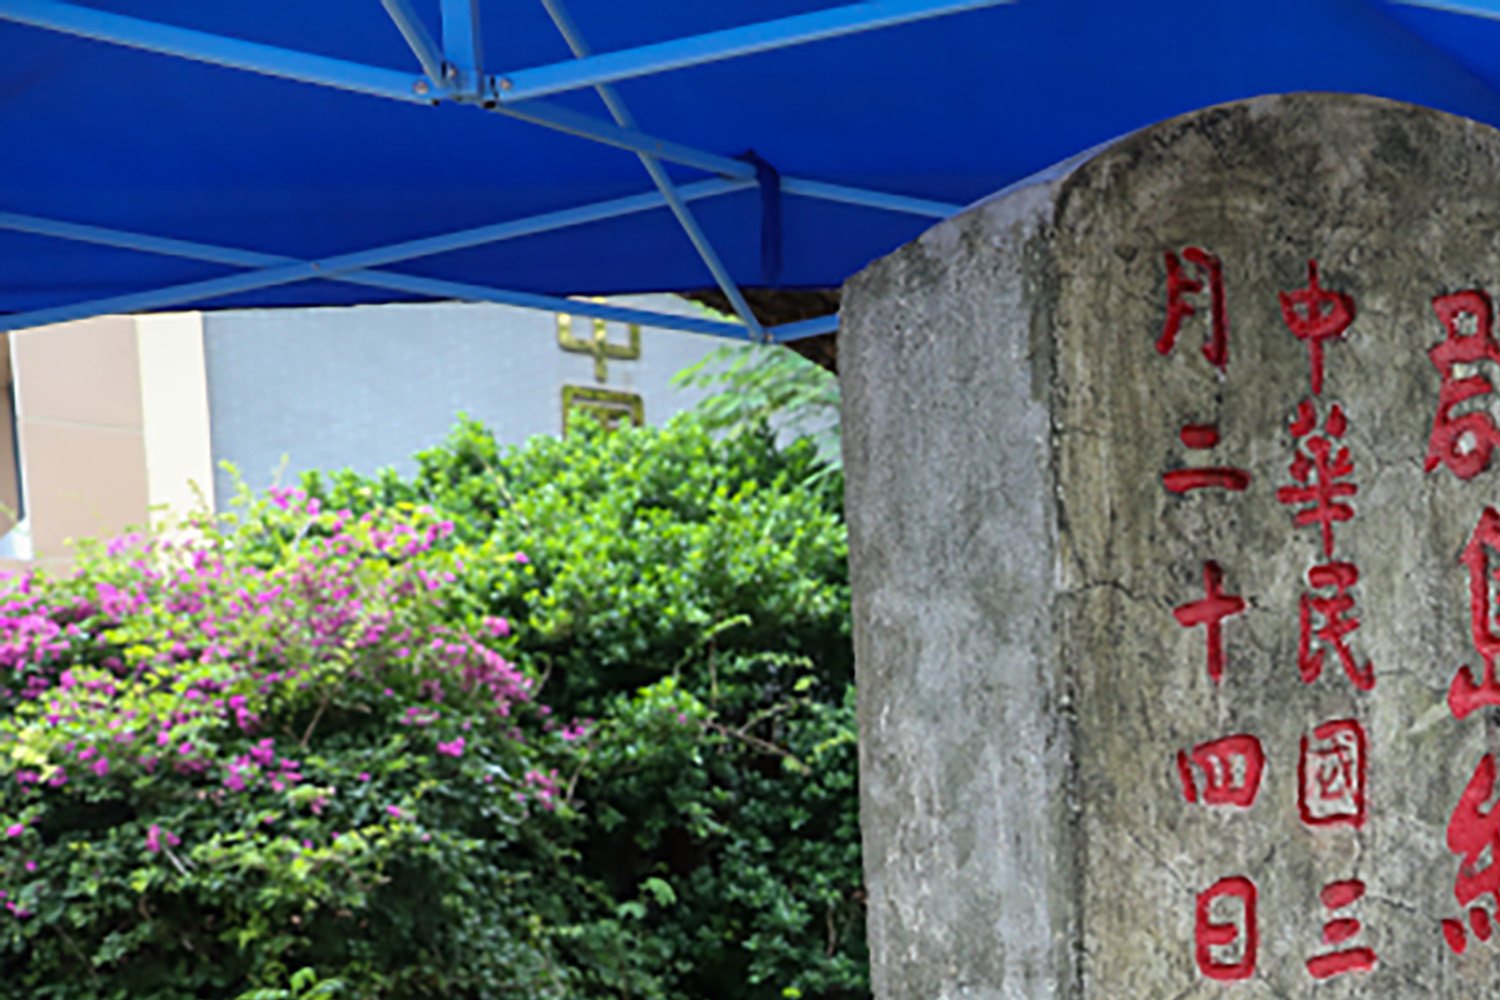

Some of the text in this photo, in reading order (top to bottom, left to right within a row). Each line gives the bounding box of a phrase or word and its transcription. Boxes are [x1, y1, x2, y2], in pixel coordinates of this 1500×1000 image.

[1155, 246, 1266, 984] 月二十四日
